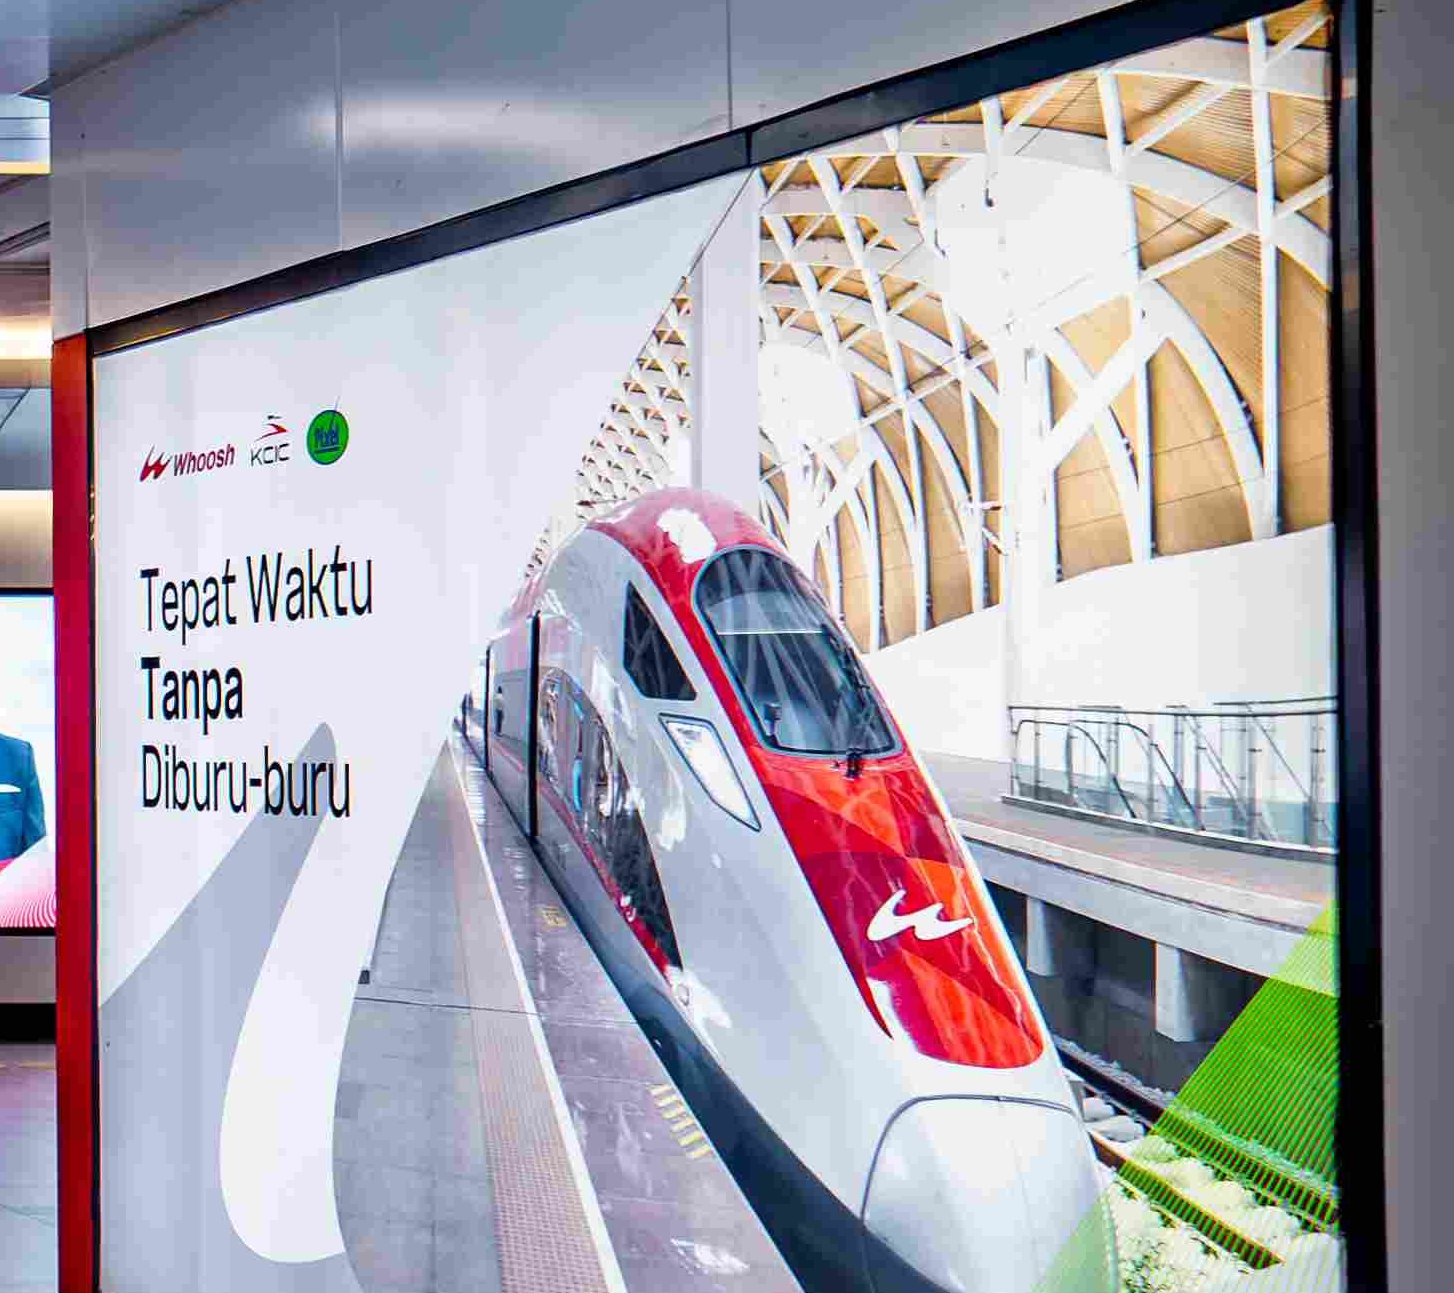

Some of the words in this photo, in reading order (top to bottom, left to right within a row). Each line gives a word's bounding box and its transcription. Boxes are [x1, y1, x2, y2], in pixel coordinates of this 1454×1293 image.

[250, 443, 291, 468] KCIC
[140, 559, 237, 646] Tepat
[246, 545, 373, 624] Waktu
[141, 657, 244, 735] Tanpa
[141, 745, 351, 818] Diburu-buru
